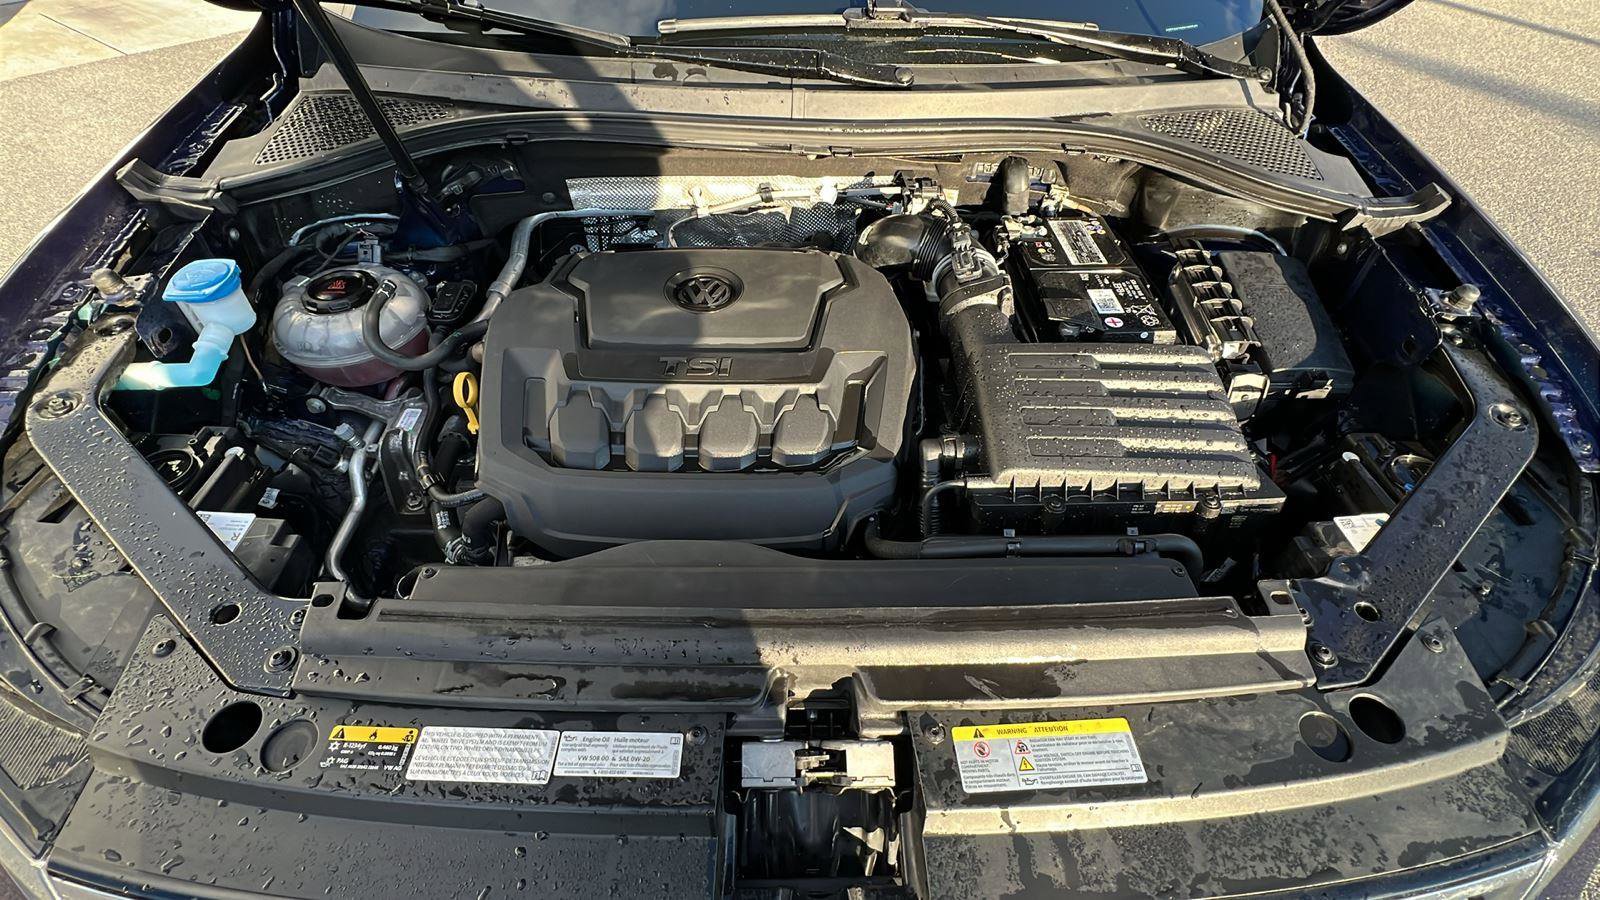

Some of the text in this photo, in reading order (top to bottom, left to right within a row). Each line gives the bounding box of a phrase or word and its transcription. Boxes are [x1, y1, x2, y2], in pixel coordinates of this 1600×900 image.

[658, 356, 734, 377] TSI
[996, 725, 1069, 735] WARNING ATTENTION
